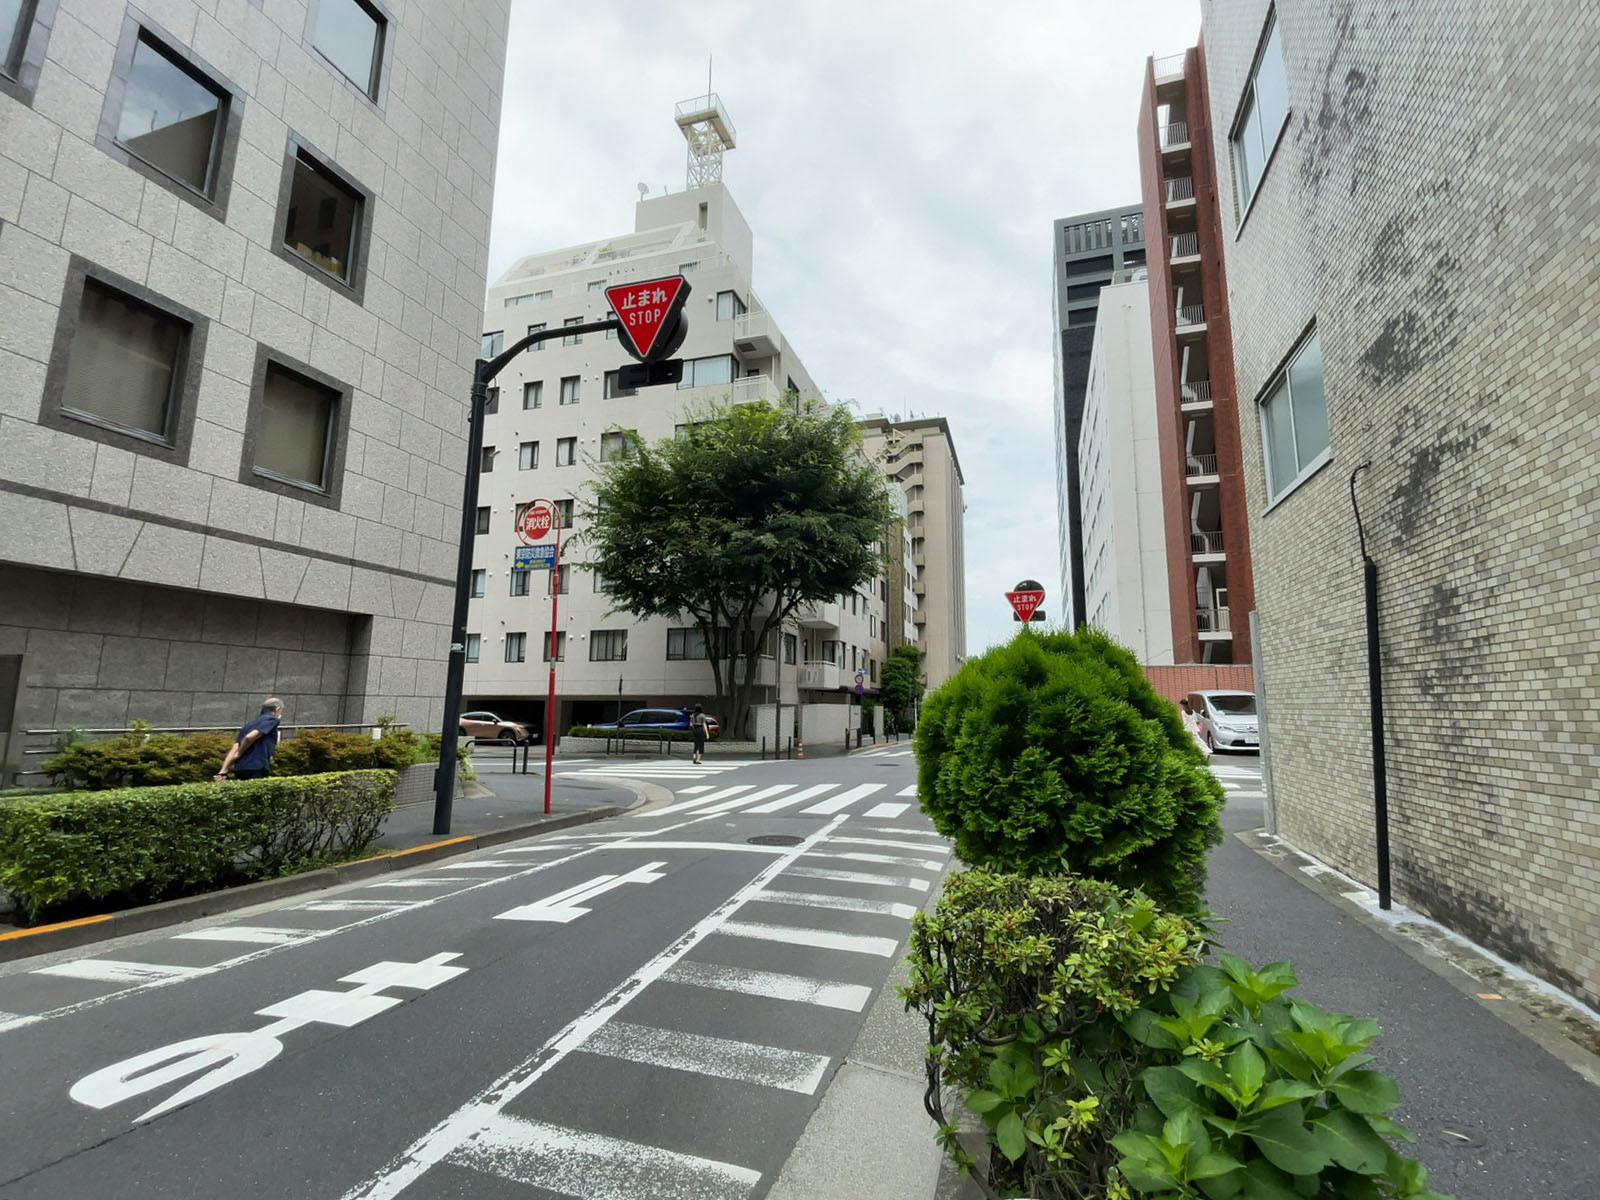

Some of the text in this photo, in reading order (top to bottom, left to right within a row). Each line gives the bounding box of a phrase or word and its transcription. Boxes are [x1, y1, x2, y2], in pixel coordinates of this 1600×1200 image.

[621, 287, 668, 310] 止まれ
[629, 308, 661, 326] STOP
[526, 515, 550, 530] 消火栓
[1017, 603, 1034, 611] STOP
